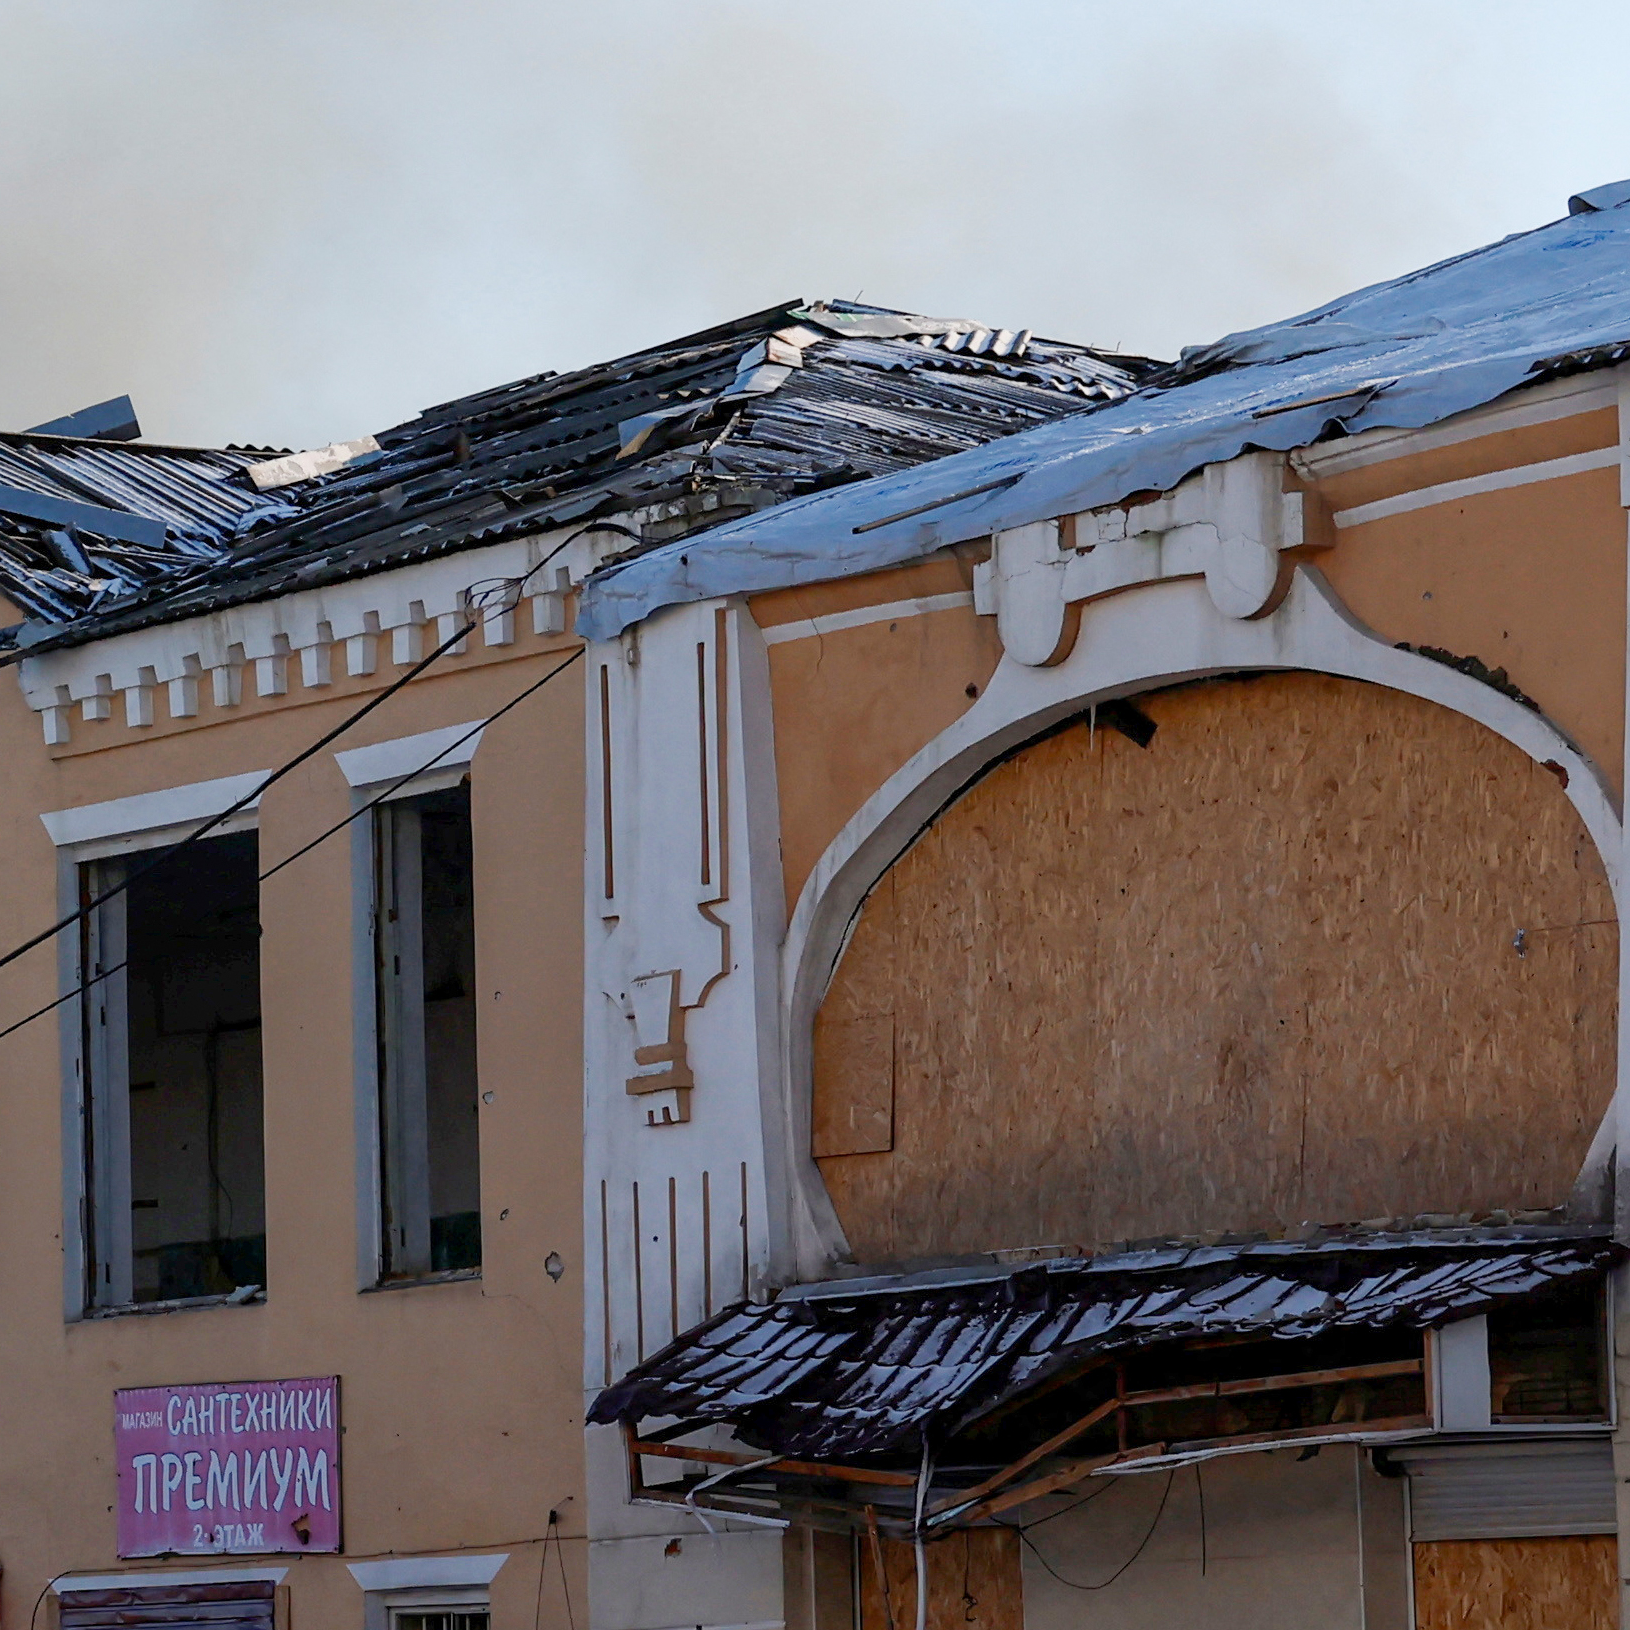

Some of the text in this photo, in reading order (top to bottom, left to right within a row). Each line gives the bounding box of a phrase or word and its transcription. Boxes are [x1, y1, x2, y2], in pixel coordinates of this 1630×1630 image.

[121, 1387, 332, 1436] МАГАЗИН САНТЕХНИКИ
[132, 1446, 331, 1514] ПРЕМИУМ
